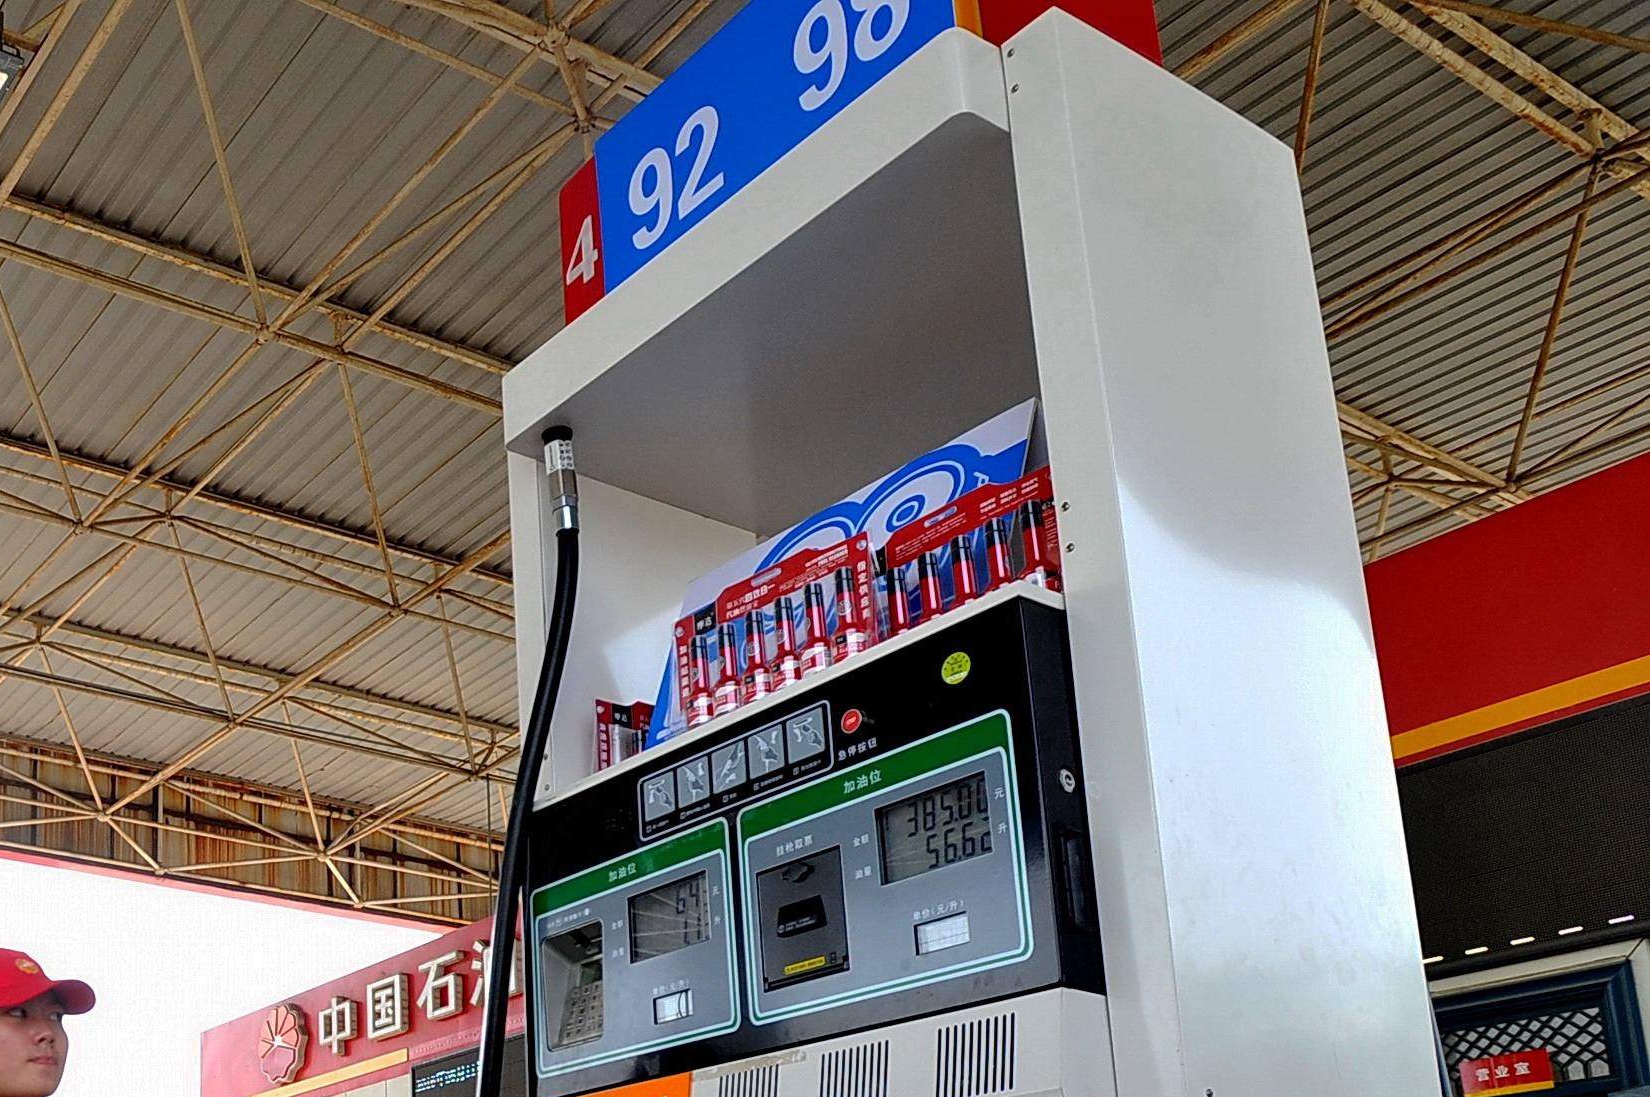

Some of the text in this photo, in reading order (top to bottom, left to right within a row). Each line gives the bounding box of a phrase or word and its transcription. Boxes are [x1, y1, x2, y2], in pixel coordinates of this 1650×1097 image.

[794, 0, 910, 111] 98
[629, 105, 725, 250] 92
[566, 214, 599, 284] 4
[838, 737, 878, 761] 急停按钮
[843, 769, 883, 794] 加油位
[994, 787, 1005, 799] 元
[997, 823, 1008, 834] 升
[608, 862, 638, 882] 加油位
[1475, 1061, 1530, 1082] 营业室
